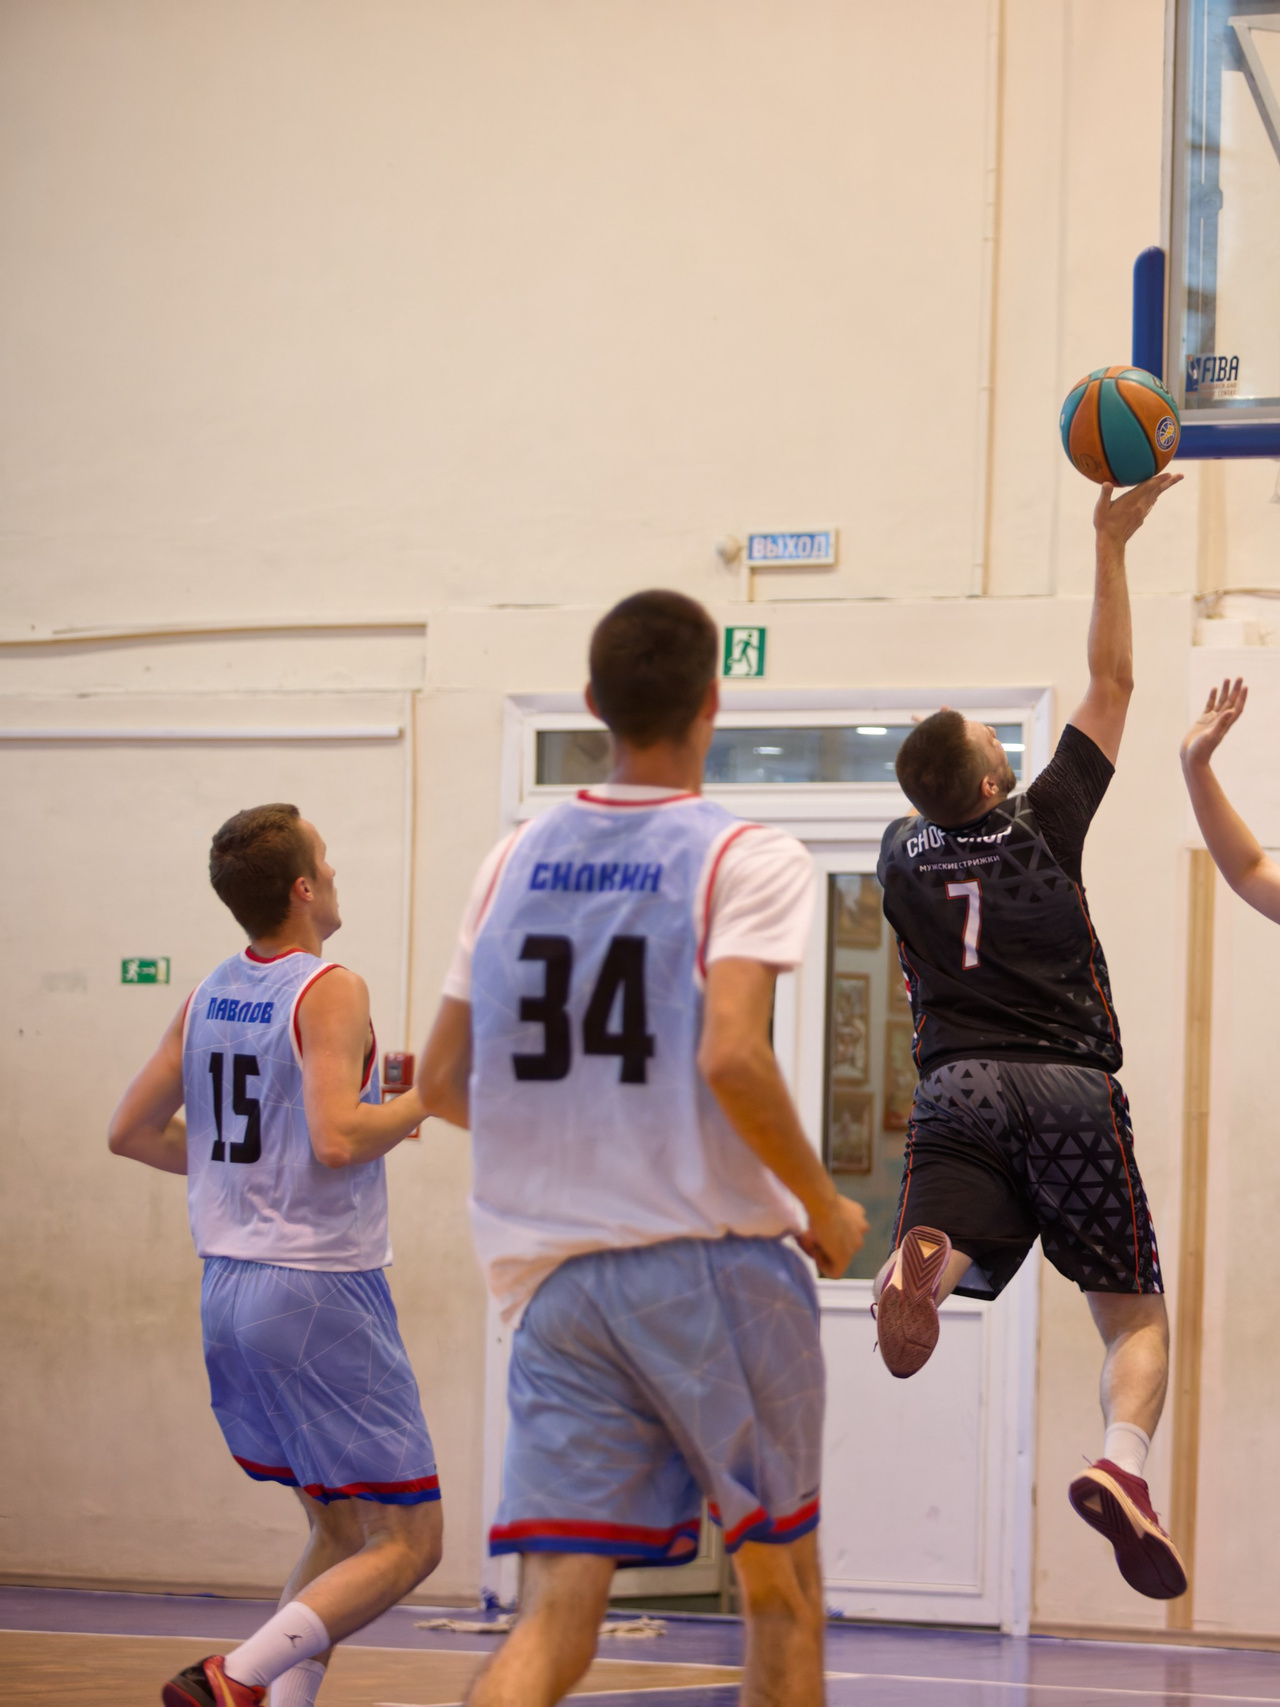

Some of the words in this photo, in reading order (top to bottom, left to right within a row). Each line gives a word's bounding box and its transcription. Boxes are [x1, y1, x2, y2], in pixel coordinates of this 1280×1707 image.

[1201, 355, 1240, 383] FIBA
[752, 534, 827, 558] ВЫХОД
[529, 862, 663, 893] СИЛКИН
[945, 878, 983, 970] 7
[206, 997, 275, 1024] ПАВЛОВ
[511, 933, 657, 1085] 34
[208, 1051, 262, 1164] 15
